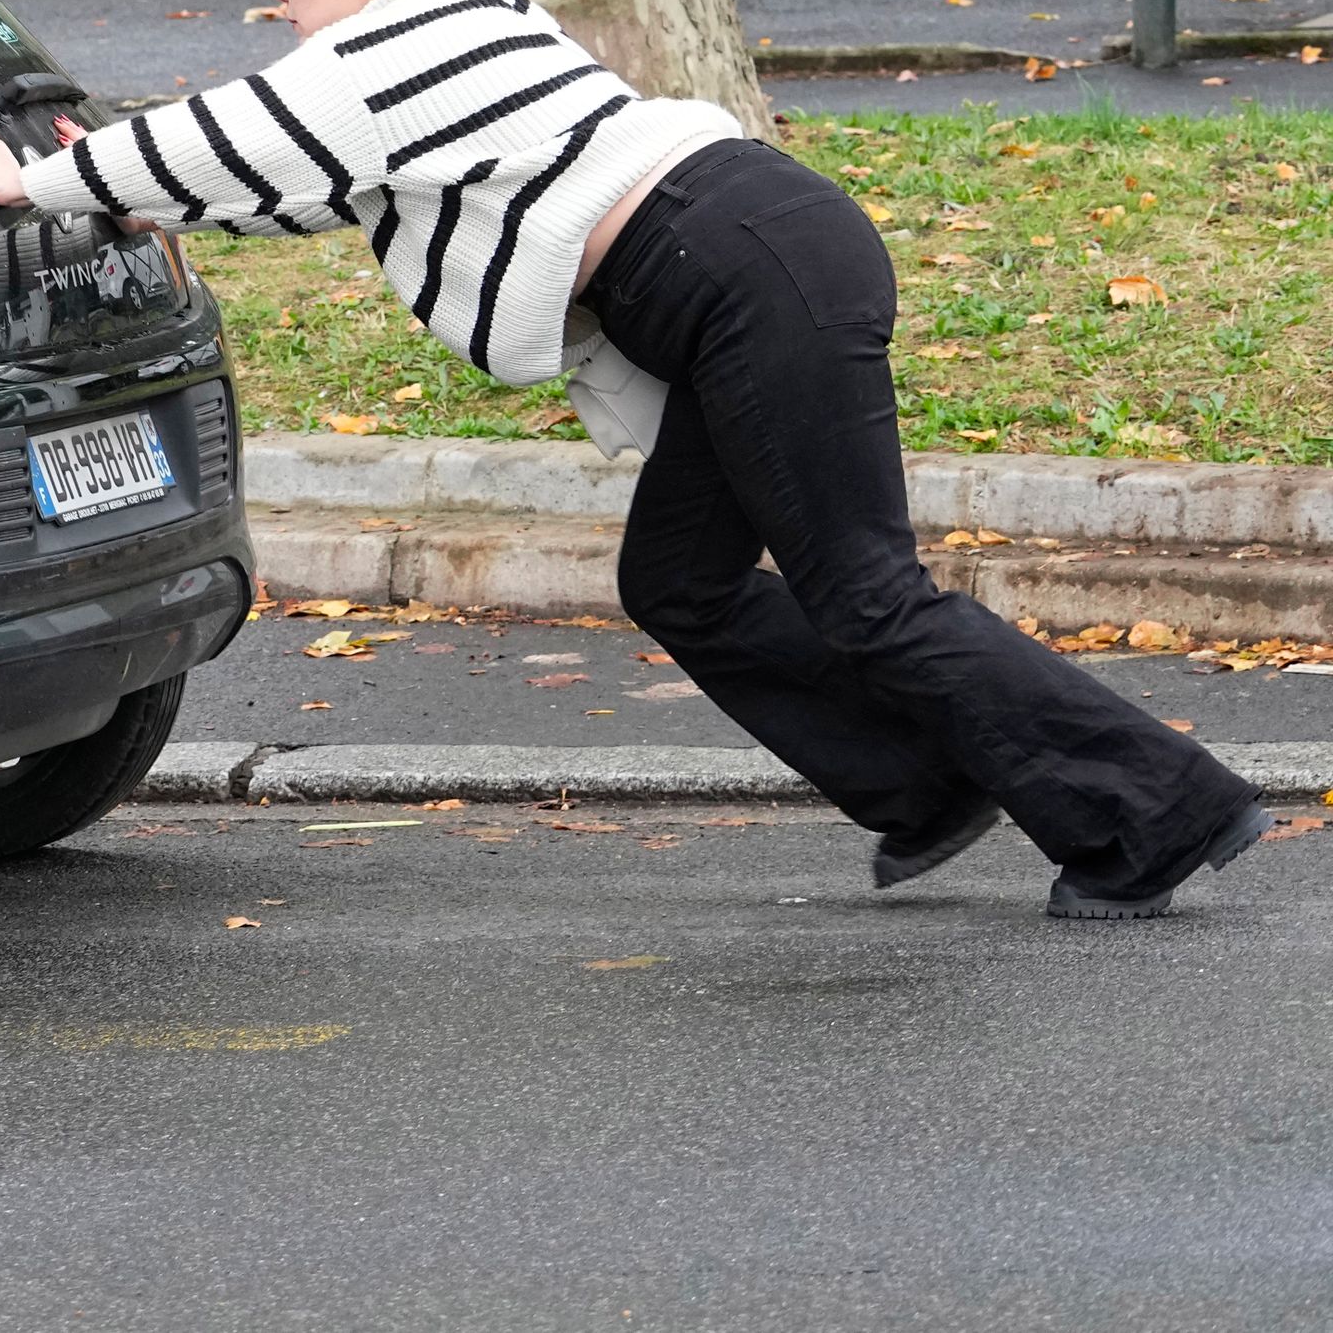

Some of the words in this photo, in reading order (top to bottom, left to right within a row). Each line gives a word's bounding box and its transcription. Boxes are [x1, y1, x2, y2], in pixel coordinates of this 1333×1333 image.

[38, 422, 156, 503] DR-998-VR
[154, 449, 171, 479] 33
[38, 487, 47, 505] F
